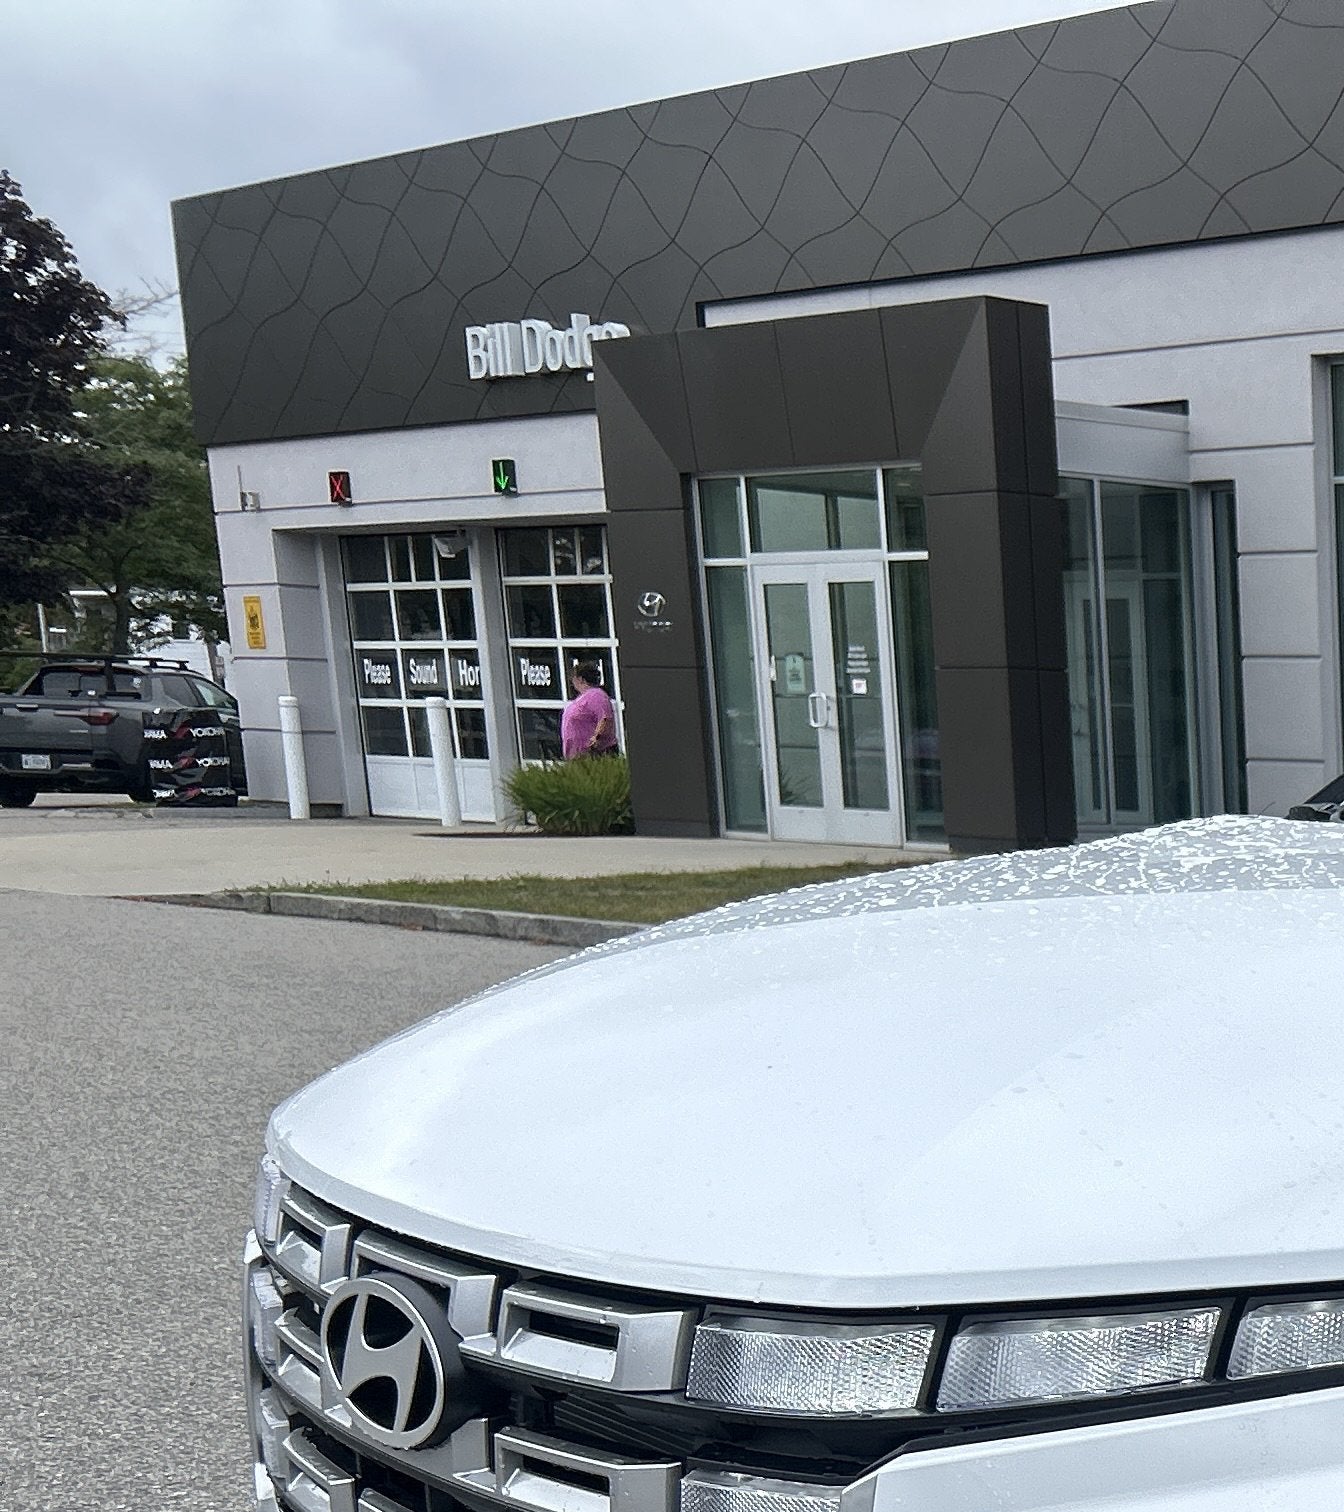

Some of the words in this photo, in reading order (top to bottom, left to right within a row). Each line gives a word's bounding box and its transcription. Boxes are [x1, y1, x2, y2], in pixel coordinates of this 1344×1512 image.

[465, 322, 525, 380] Bill
[363, 658, 391, 685] Please
[409, 658, 438, 685] Sound
[457, 659, 480, 686] Hor
[520, 657, 551, 686] Please
